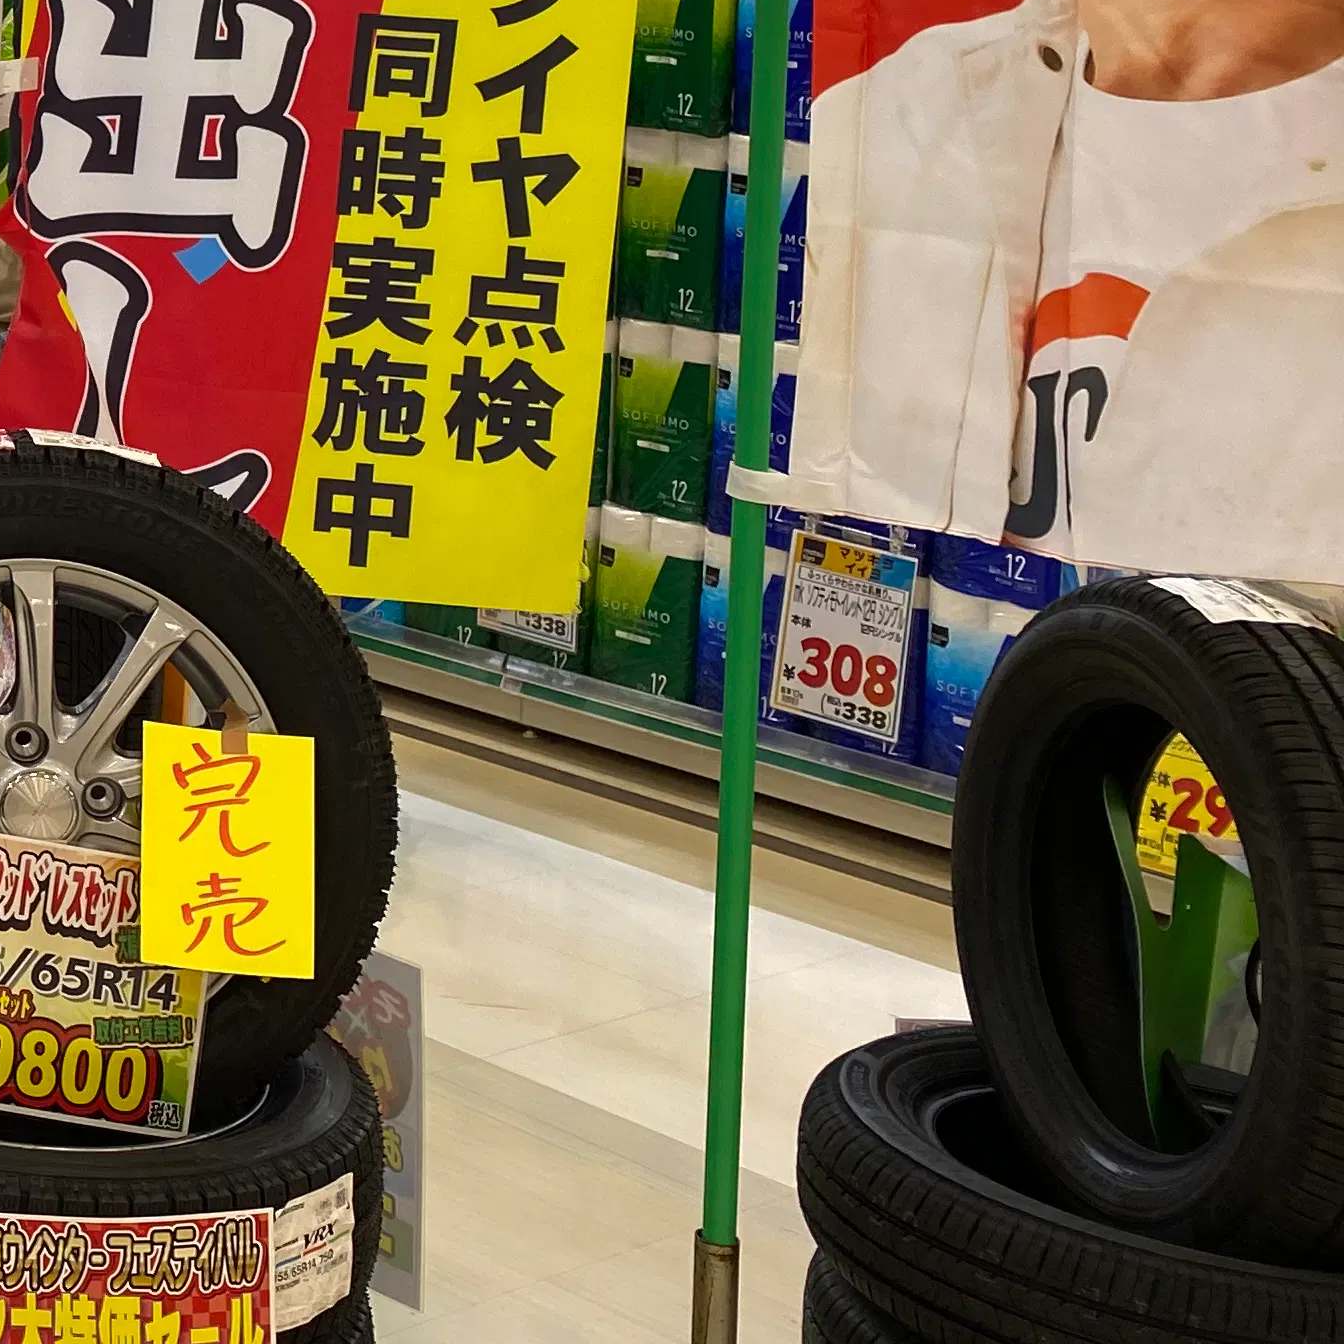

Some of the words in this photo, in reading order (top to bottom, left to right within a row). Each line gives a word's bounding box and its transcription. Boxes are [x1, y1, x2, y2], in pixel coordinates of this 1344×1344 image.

[311, 12, 460, 570] 同時実施中
[171, 742, 287, 958] 完売
[303, 1218, 338, 1246] VRX
